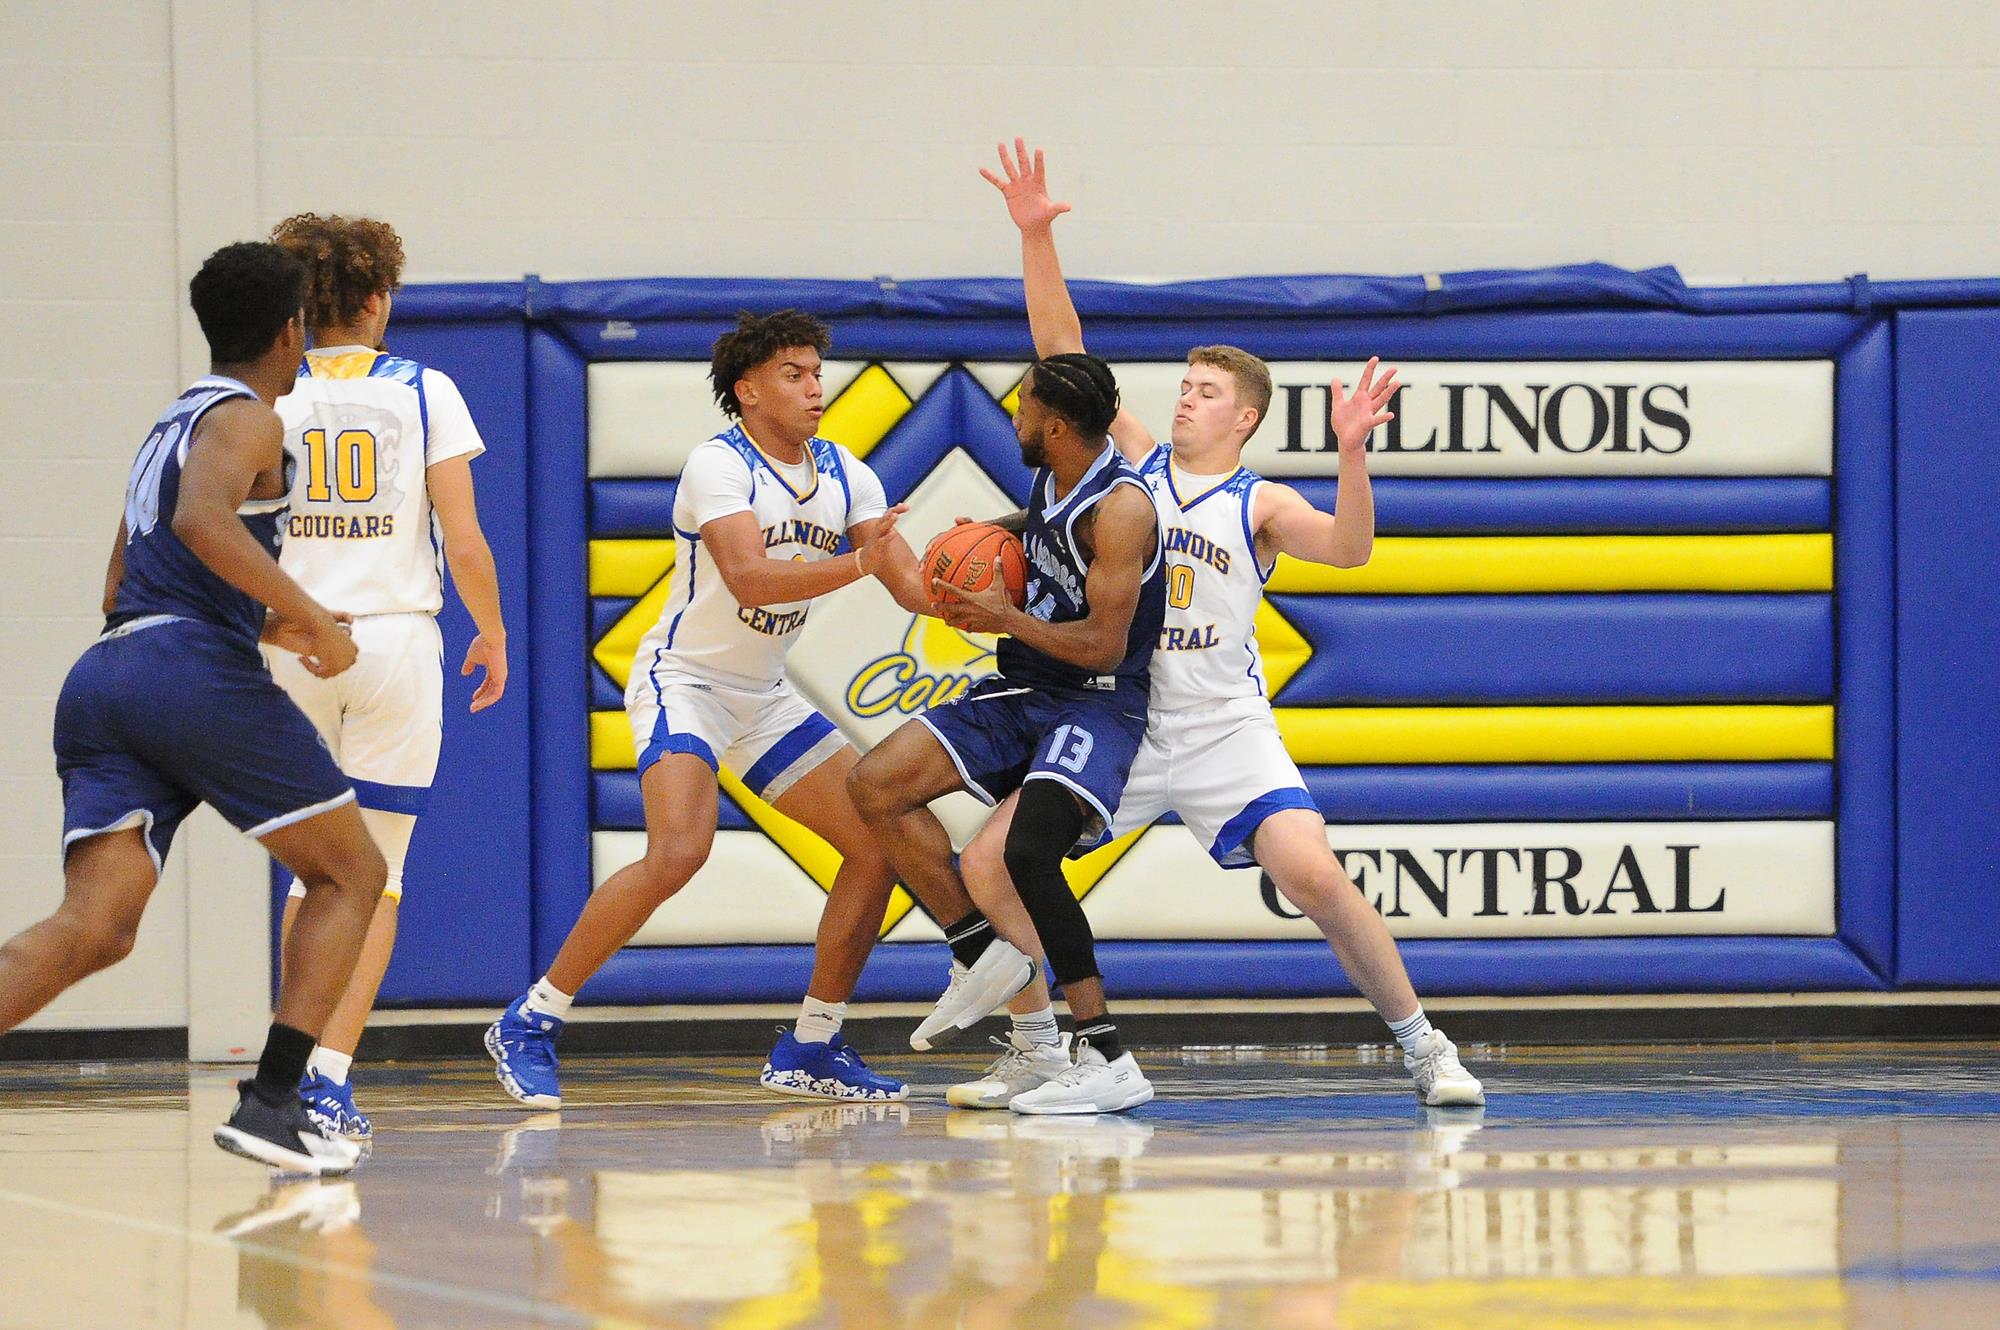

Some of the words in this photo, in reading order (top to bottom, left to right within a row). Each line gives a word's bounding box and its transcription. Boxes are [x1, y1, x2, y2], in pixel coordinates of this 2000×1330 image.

[302, 427, 377, 502] 10
[289, 514, 394, 538] COUGARS
[1165, 528, 1230, 575] INOIS
[1166, 562, 1195, 610] 0
[737, 606, 810, 635] CENTRA
[1045, 725, 1094, 773] 13
